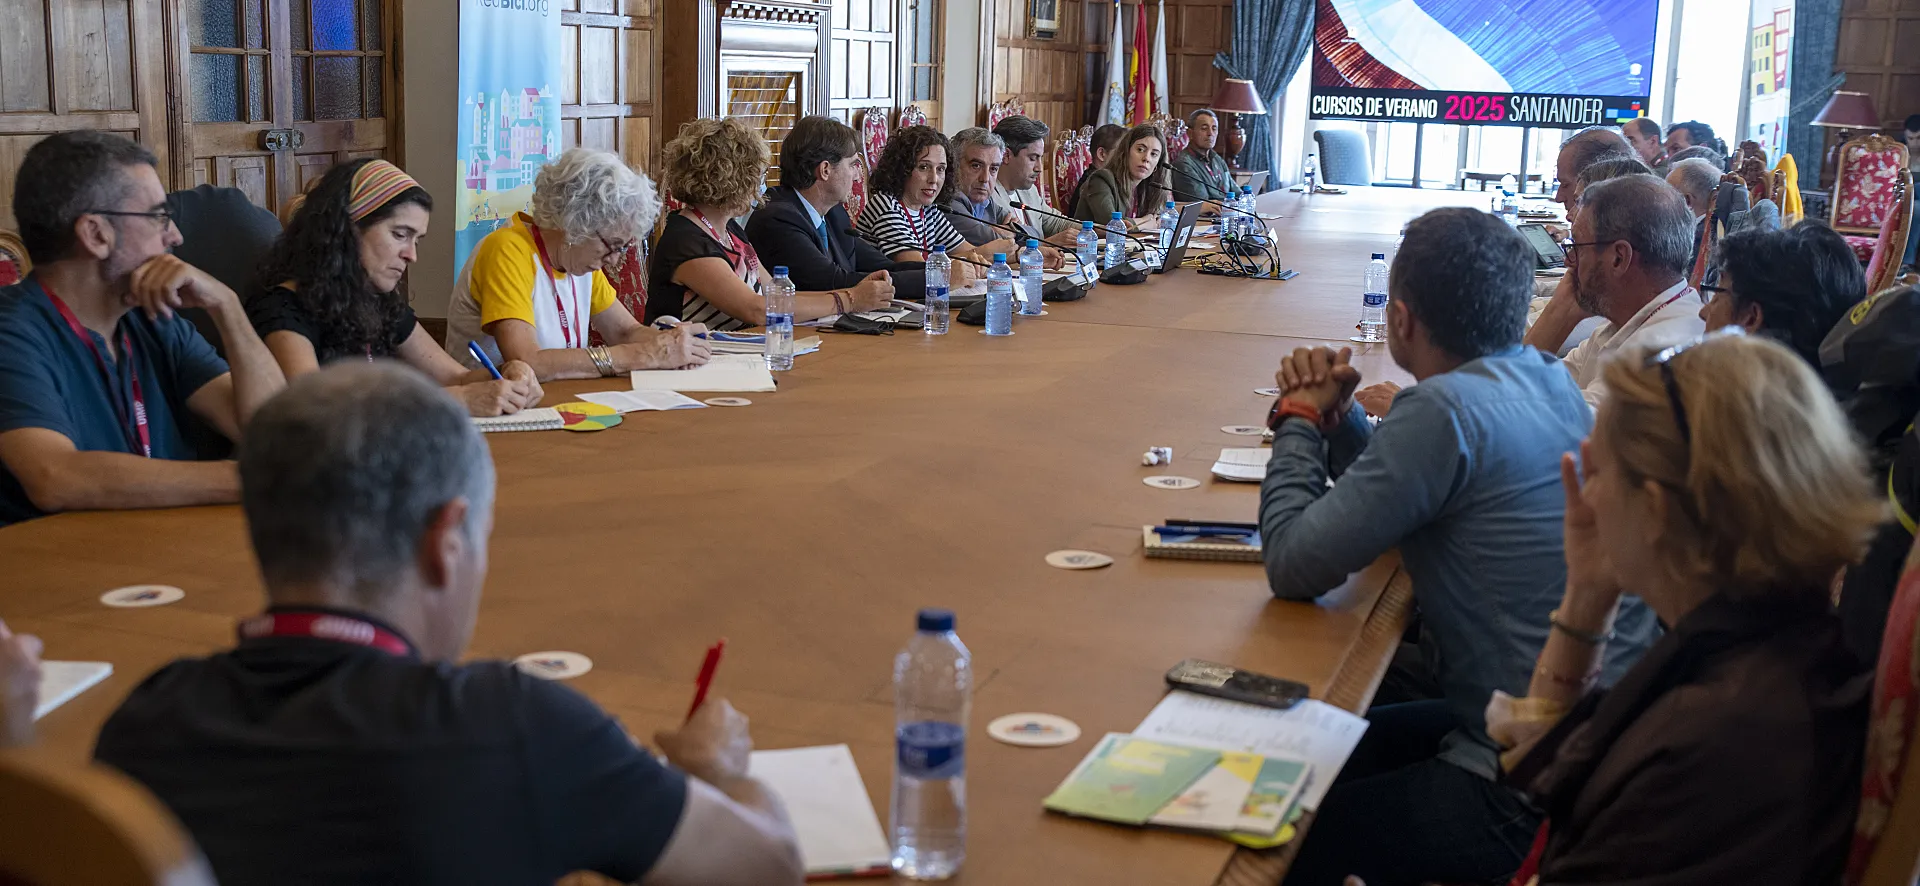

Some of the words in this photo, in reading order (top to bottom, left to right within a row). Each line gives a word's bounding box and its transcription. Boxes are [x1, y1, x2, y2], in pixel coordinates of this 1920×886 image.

[1312, 95, 1362, 115] CURSOS
[1365, 97, 1383, 117] DE
[1385, 98, 1438, 118] VERANO
[1444, 95, 1505, 121] 2025
[1508, 96, 1603, 124] SANTANDER
[134, 400, 147, 425] UIMP
